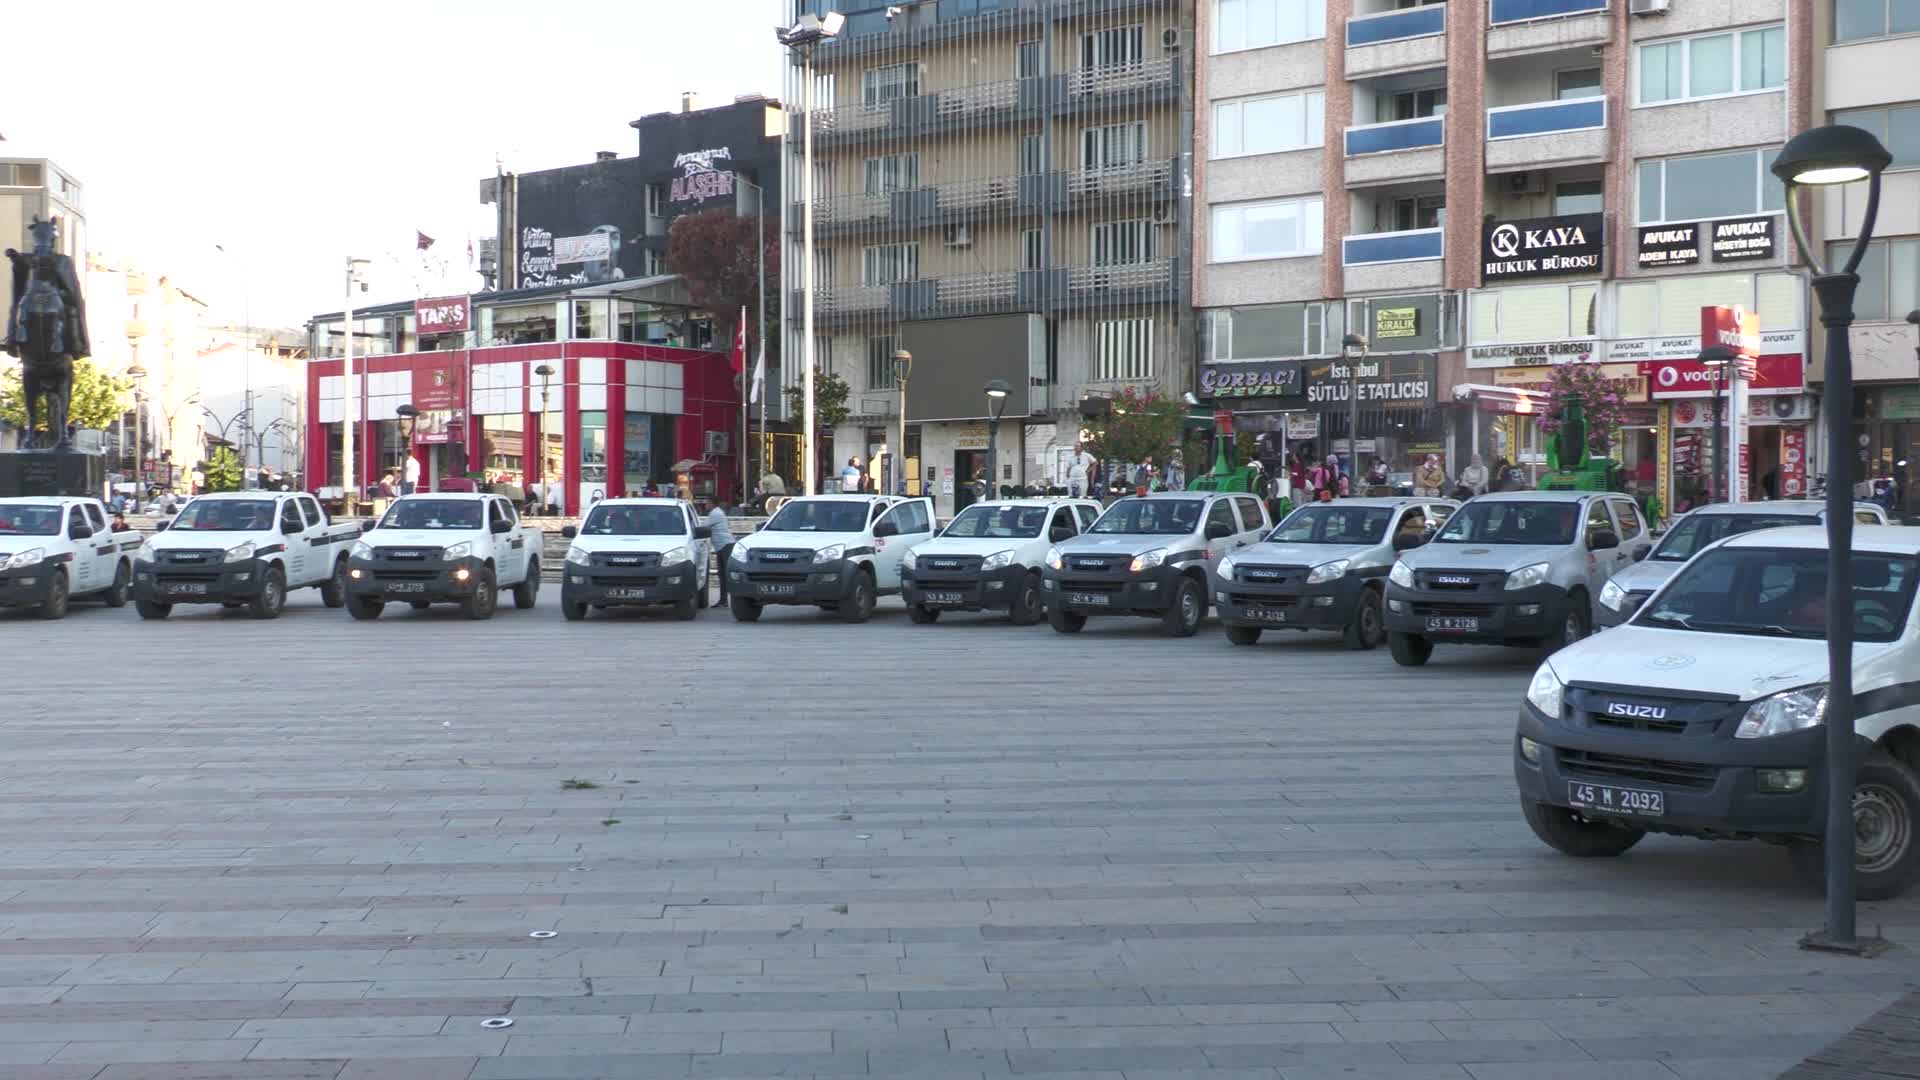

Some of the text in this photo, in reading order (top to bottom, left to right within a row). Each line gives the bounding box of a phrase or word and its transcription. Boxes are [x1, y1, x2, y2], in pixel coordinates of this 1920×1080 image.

[1717, 221, 1768, 236] AVUKAT
[1524, 226, 1587, 249] KAYA
[1643, 229, 1693, 244] AVUKAT
[1640, 249, 1697, 262] ADEM KAYA
[1486, 254, 1599, 274] HUKUK BÜROSU
[1662, 339, 1692, 347] AVUKAT
[1762, 334, 1795, 342] AVUKAT
[1508, 344, 1546, 357] HUKUK
[1549, 342, 1593, 355] BÜROSU
[1615, 342, 1644, 350] AVUKAT
[1307, 380, 1349, 402] SÜTLÜ
[1367, 381, 1428, 400] TATLICISI
[1439, 576, 1470, 584] ISUZU
[1430, 619, 1441, 627] 45
[1607, 702, 1666, 719] ISUZU
[1577, 786, 1595, 802] 45
[1602, 788, 1612, 804] M
[1620, 791, 1661, 811] 2092
